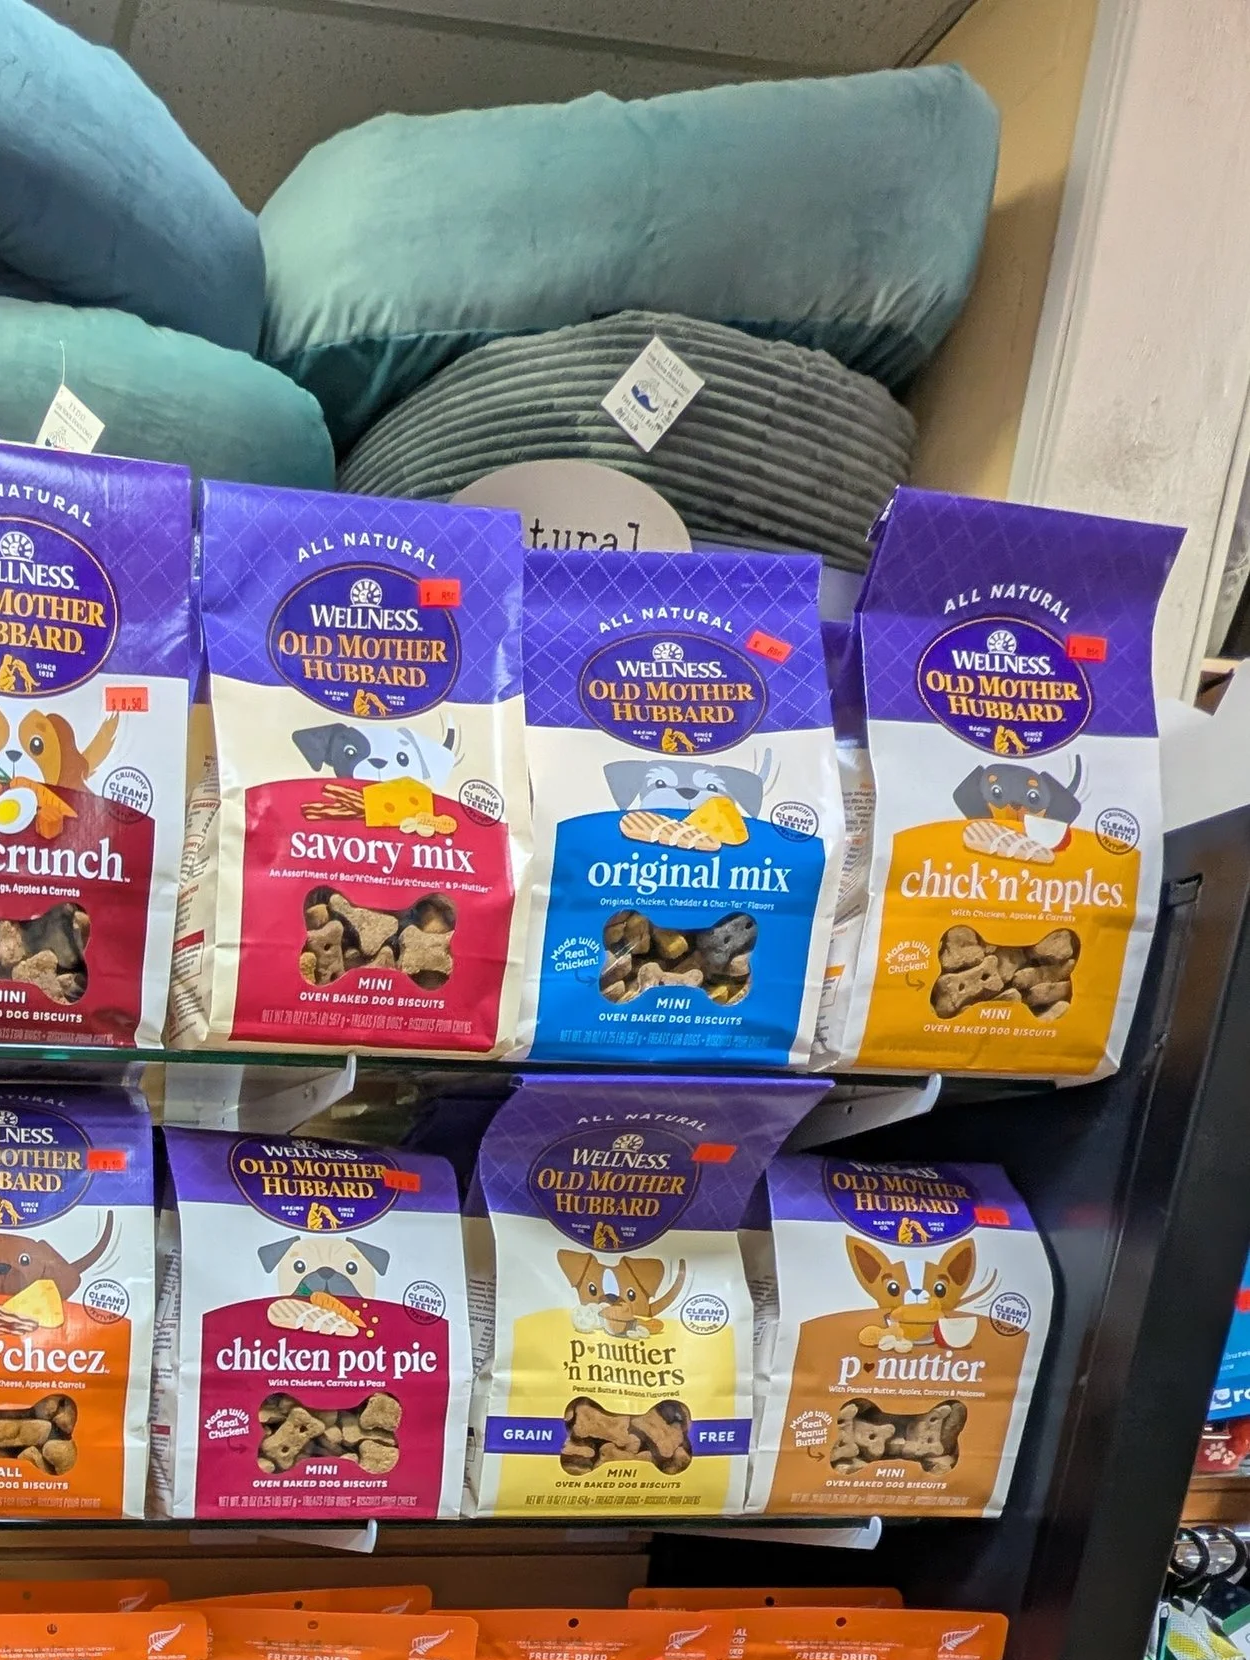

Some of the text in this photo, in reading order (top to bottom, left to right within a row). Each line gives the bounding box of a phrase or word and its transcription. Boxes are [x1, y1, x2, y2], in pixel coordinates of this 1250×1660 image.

[529, 519, 640, 551] tural
[310, 604, 418, 631] WELLNESS
[599, 607, 734, 633] ALL NATURAL
[279, 631, 447, 663] OLD MOTHER
[616, 660, 722, 679] WELLNESS
[951, 650, 1051, 675] WELLNESS
[303, 660, 426, 688] HUBBARD
[589, 680, 755, 701] OLD MOTHER
[926, 671, 1080, 700] OLD MOTHER
[611, 703, 735, 723] HUBBARD
[948, 695, 1063, 722] HUBBARD
[109, 782, 148, 803] CLEANS
[111, 793, 143, 809] TEETH
[291, 832, 475, 874] savory mix
[588, 852, 791, 894] original mix
[13, 882, 40, 896] Apples
[41, 887, 48, 895] &
[49, 887, 80, 897] Carrots
[900, 859, 1123, 913] chick'n'apples
[657, 998, 690, 1010] MINI
[7, 1010, 30, 1021] DOG
[33, 1012, 83, 1024] BISCUITS
[262, 1145, 359, 1160] WELLNESS
[572, 1148, 669, 1170] WELLNESS
[239, 1159, 386, 1179] OLD MOTHER
[263, 1176, 374, 1199] HUBBARD
[537, 1168, 685, 1195] OLD MOTHER
[833, 1173, 970, 1199] OLD MOTHER
[555, 1193, 660, 1217] HUBBARD
[854, 1193, 959, 1214] HUBBARD
[685, 1308, 725, 1316] CLEANS
[688, 1314, 720, 1322] TEETH
[216, 1337, 437, 1380] chicken pot pie
[268, 1379, 289, 1387] With
[290, 1379, 325, 1388] Chicken,
[326, 1379, 357, 1387] Carrots
[588, 1365, 684, 1387] nanners
[503, 1429, 552, 1441] GRAIN
[699, 1431, 735, 1443] FREE
